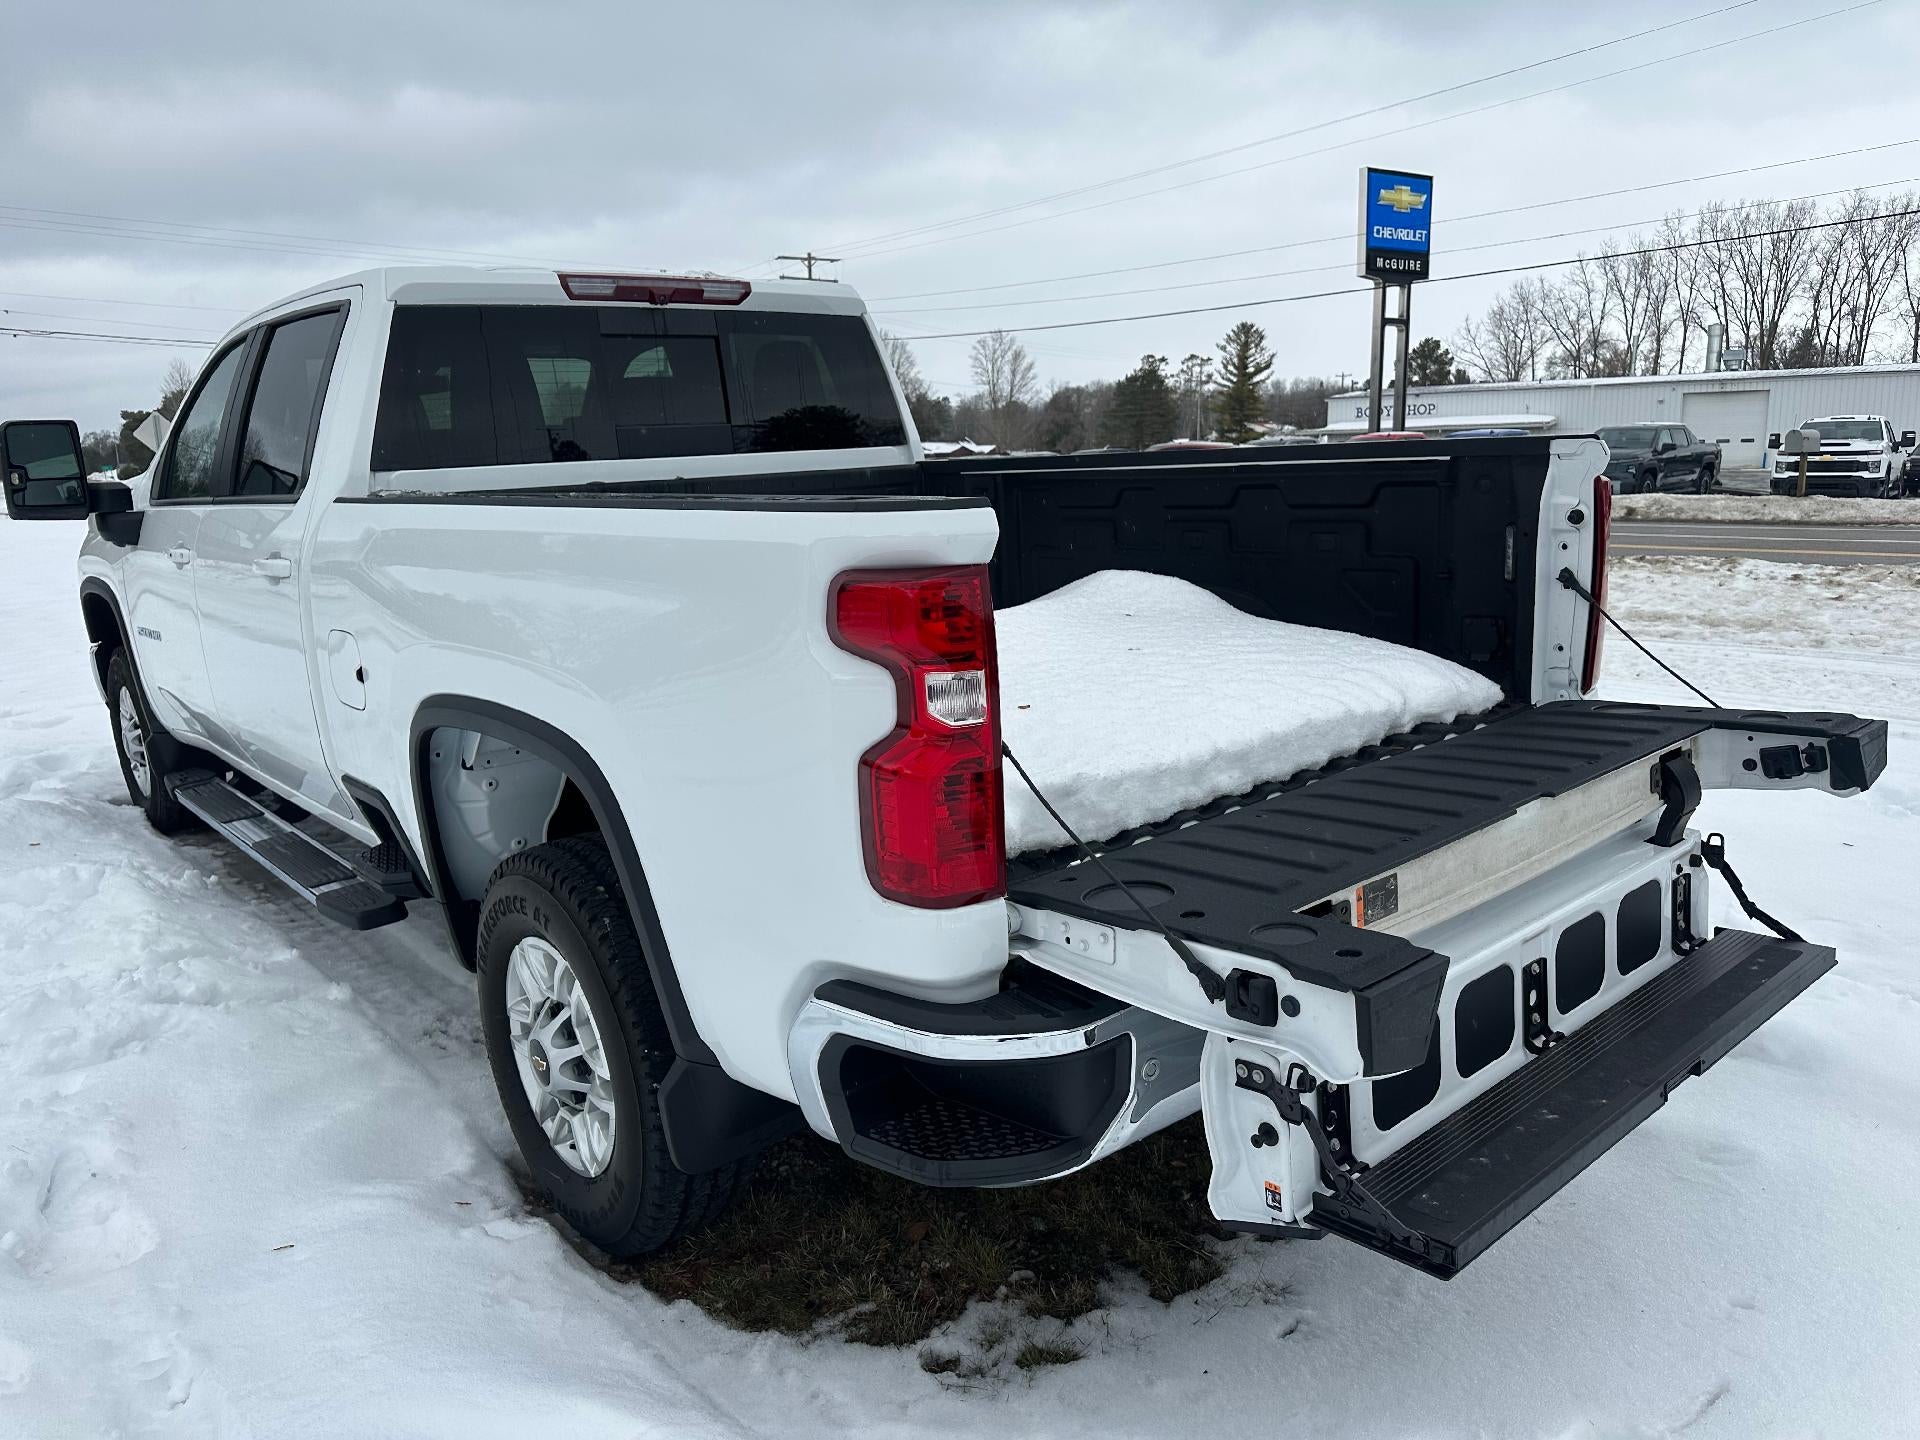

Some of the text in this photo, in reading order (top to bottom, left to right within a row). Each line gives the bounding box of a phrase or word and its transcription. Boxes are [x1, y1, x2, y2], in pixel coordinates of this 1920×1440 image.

[1373, 226, 1427, 241] CHEVROLET
[1376, 257, 1421, 271] McGUIRE
[1356, 404, 1436, 418] BOY HOP
